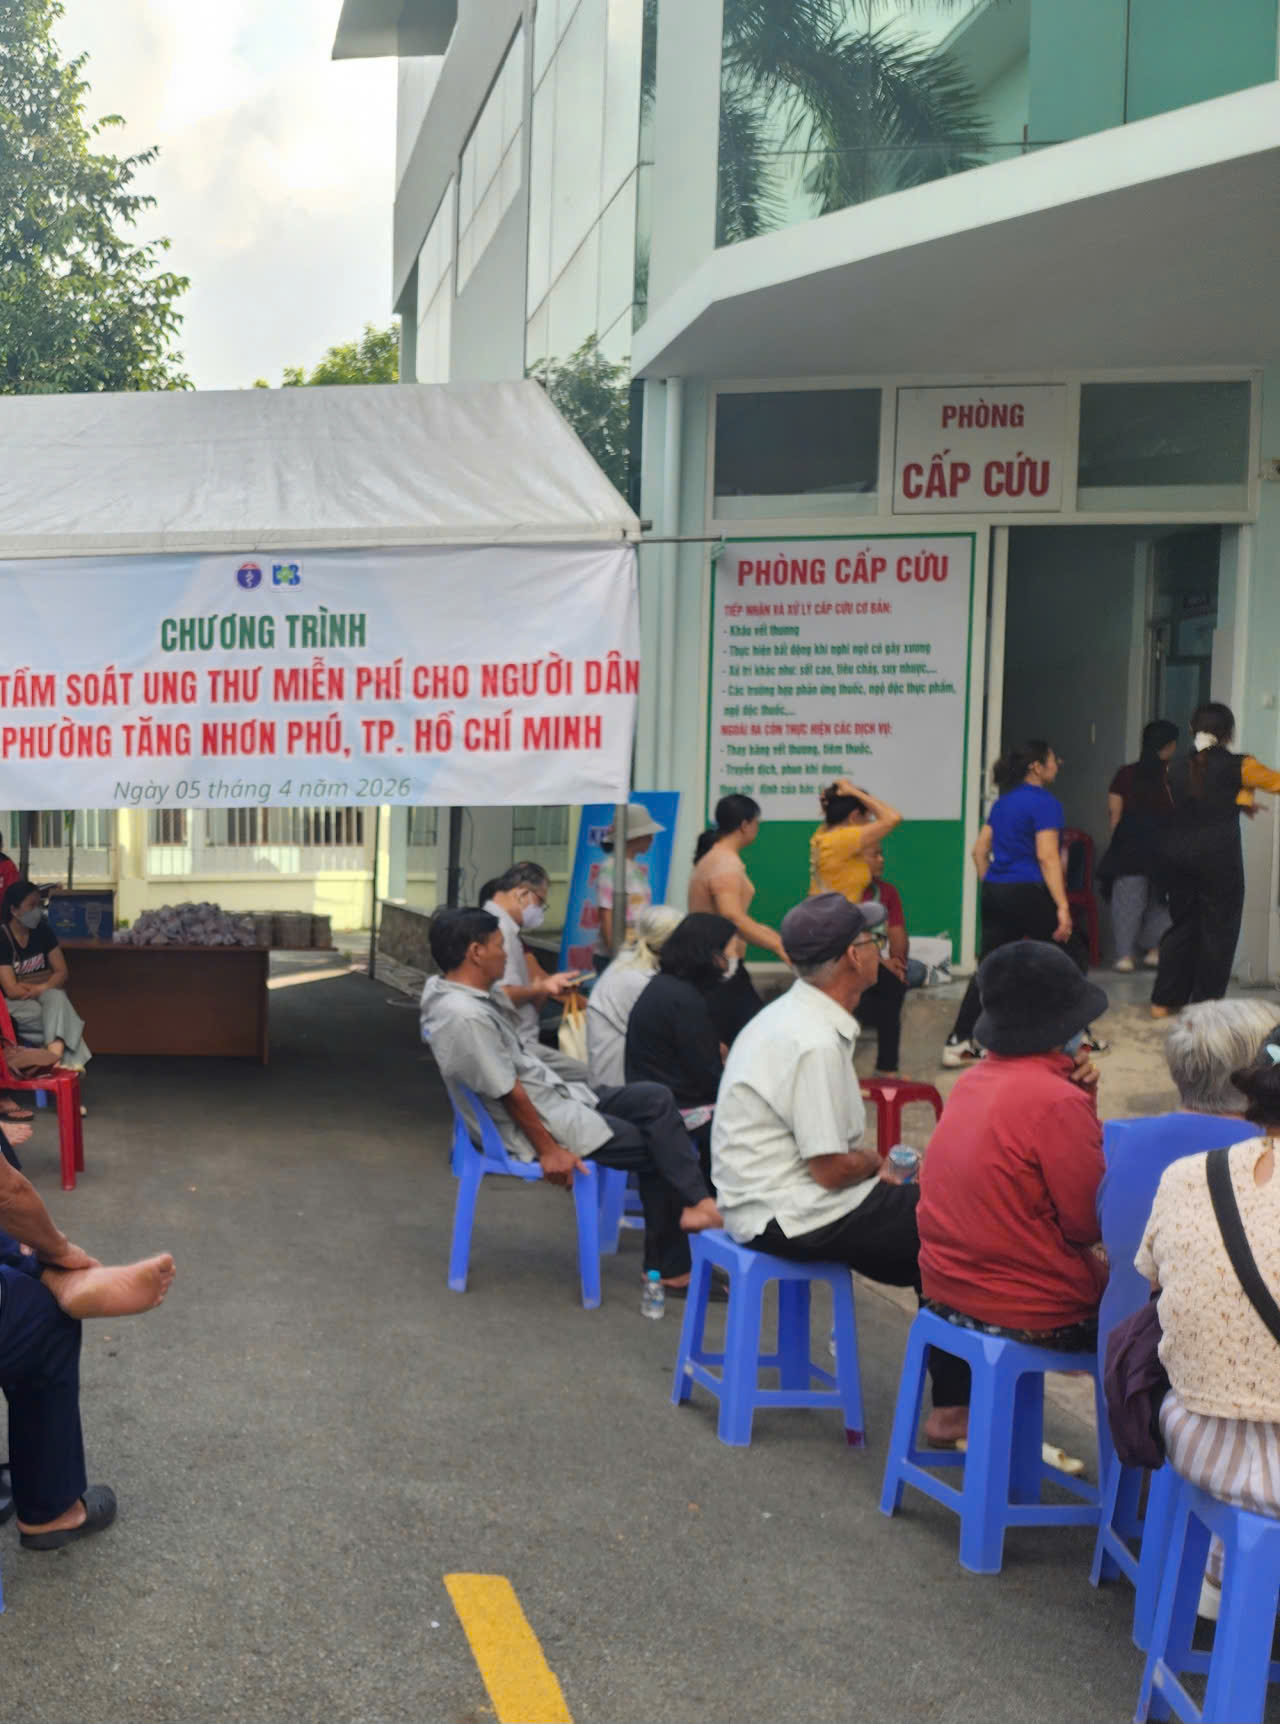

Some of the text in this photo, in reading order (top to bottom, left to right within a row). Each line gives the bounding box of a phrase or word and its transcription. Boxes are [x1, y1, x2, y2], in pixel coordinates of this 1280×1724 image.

[941, 399, 1025, 429] PHÒNG
[902, 449, 1051, 500] CẤP CỨU
[737, 547, 950, 587] PHÒNG CẤP CỨU
[161, 606, 366, 652] CHƯƠNG TRÌNH
[66, 665, 134, 707] SOÁT
[144, 670, 197, 705] UNG
[207, 666, 262, 703] THƯ
[274, 656, 345, 702] MIỄN
[356, 658, 404, 700] PHÍ
[413, 665, 470, 700] CHO
[481, 651, 573, 698] NGƯỜI
[584, 650, 640, 696] DÂN
[2, 716, 113, 760] PHƯỜNG
[122, 716, 192, 758] TĂNG
[202, 719, 277, 756] NHƠN
[287, 712, 351, 758] PHÚ,
[361, 720, 404, 754] TP.
[415, 709, 456, 753] HỒ
[464, 708, 513, 752] CHÍ
[523, 715, 603, 751] MINH
[113, 777, 412, 805] Ngày 05 tháng 4 năm 2026
